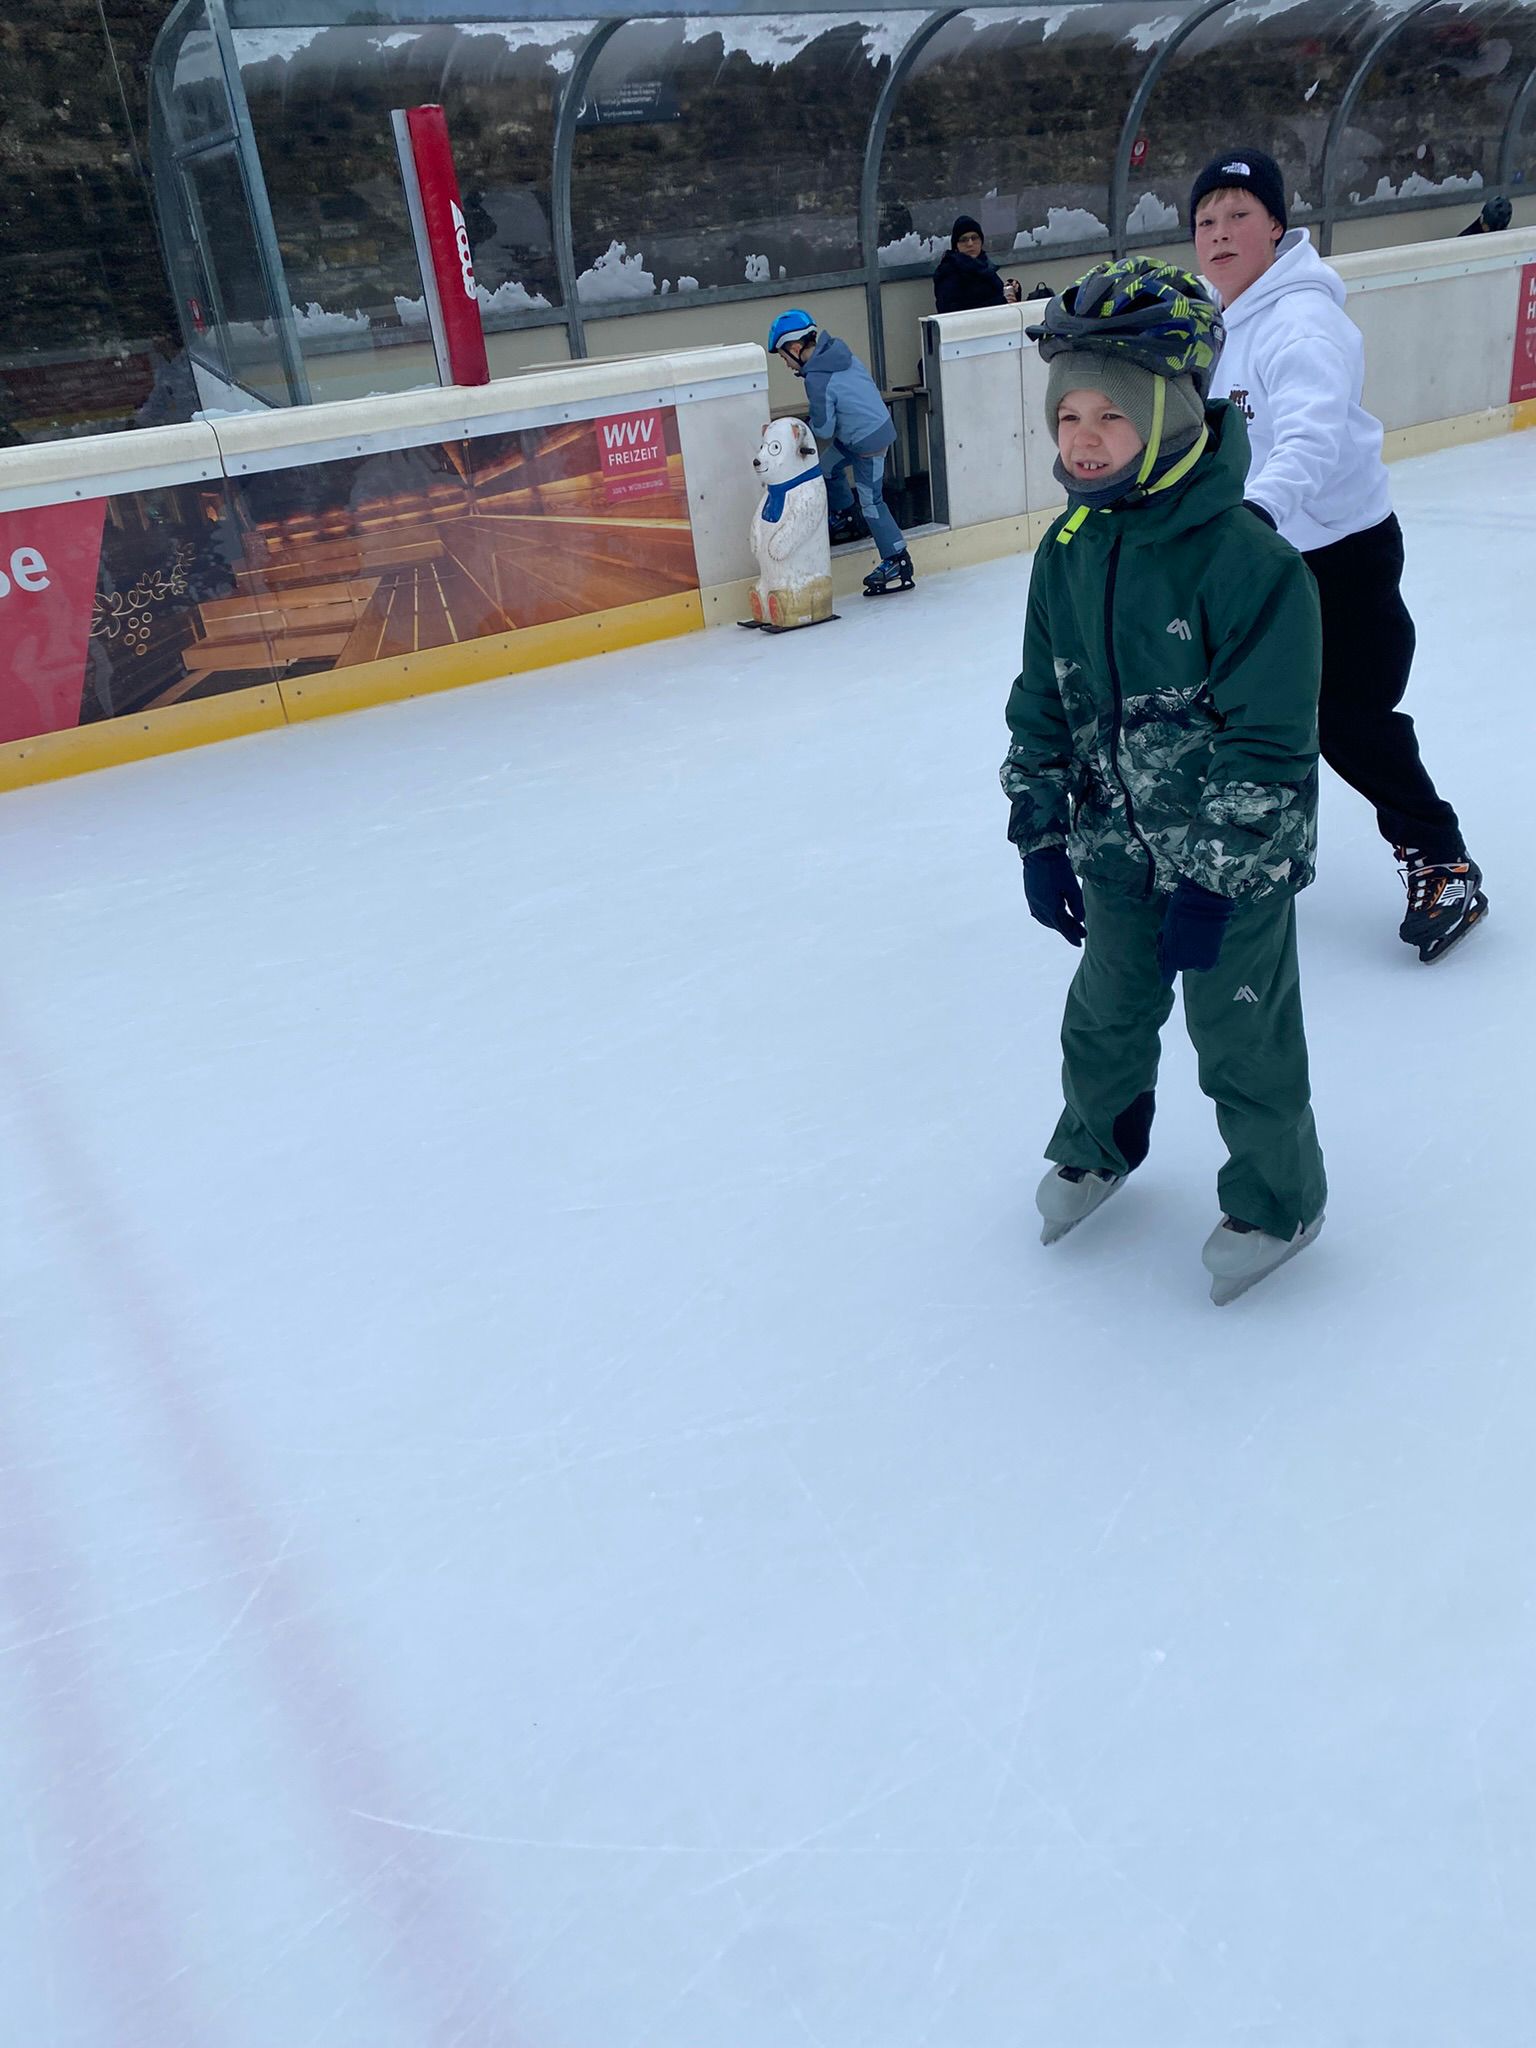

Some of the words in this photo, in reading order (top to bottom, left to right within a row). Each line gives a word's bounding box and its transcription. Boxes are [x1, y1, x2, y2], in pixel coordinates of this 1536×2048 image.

[603, 417, 655, 448] WVV
[608, 446, 658, 466] FREIZEIT
[0, 546, 50, 598] e
